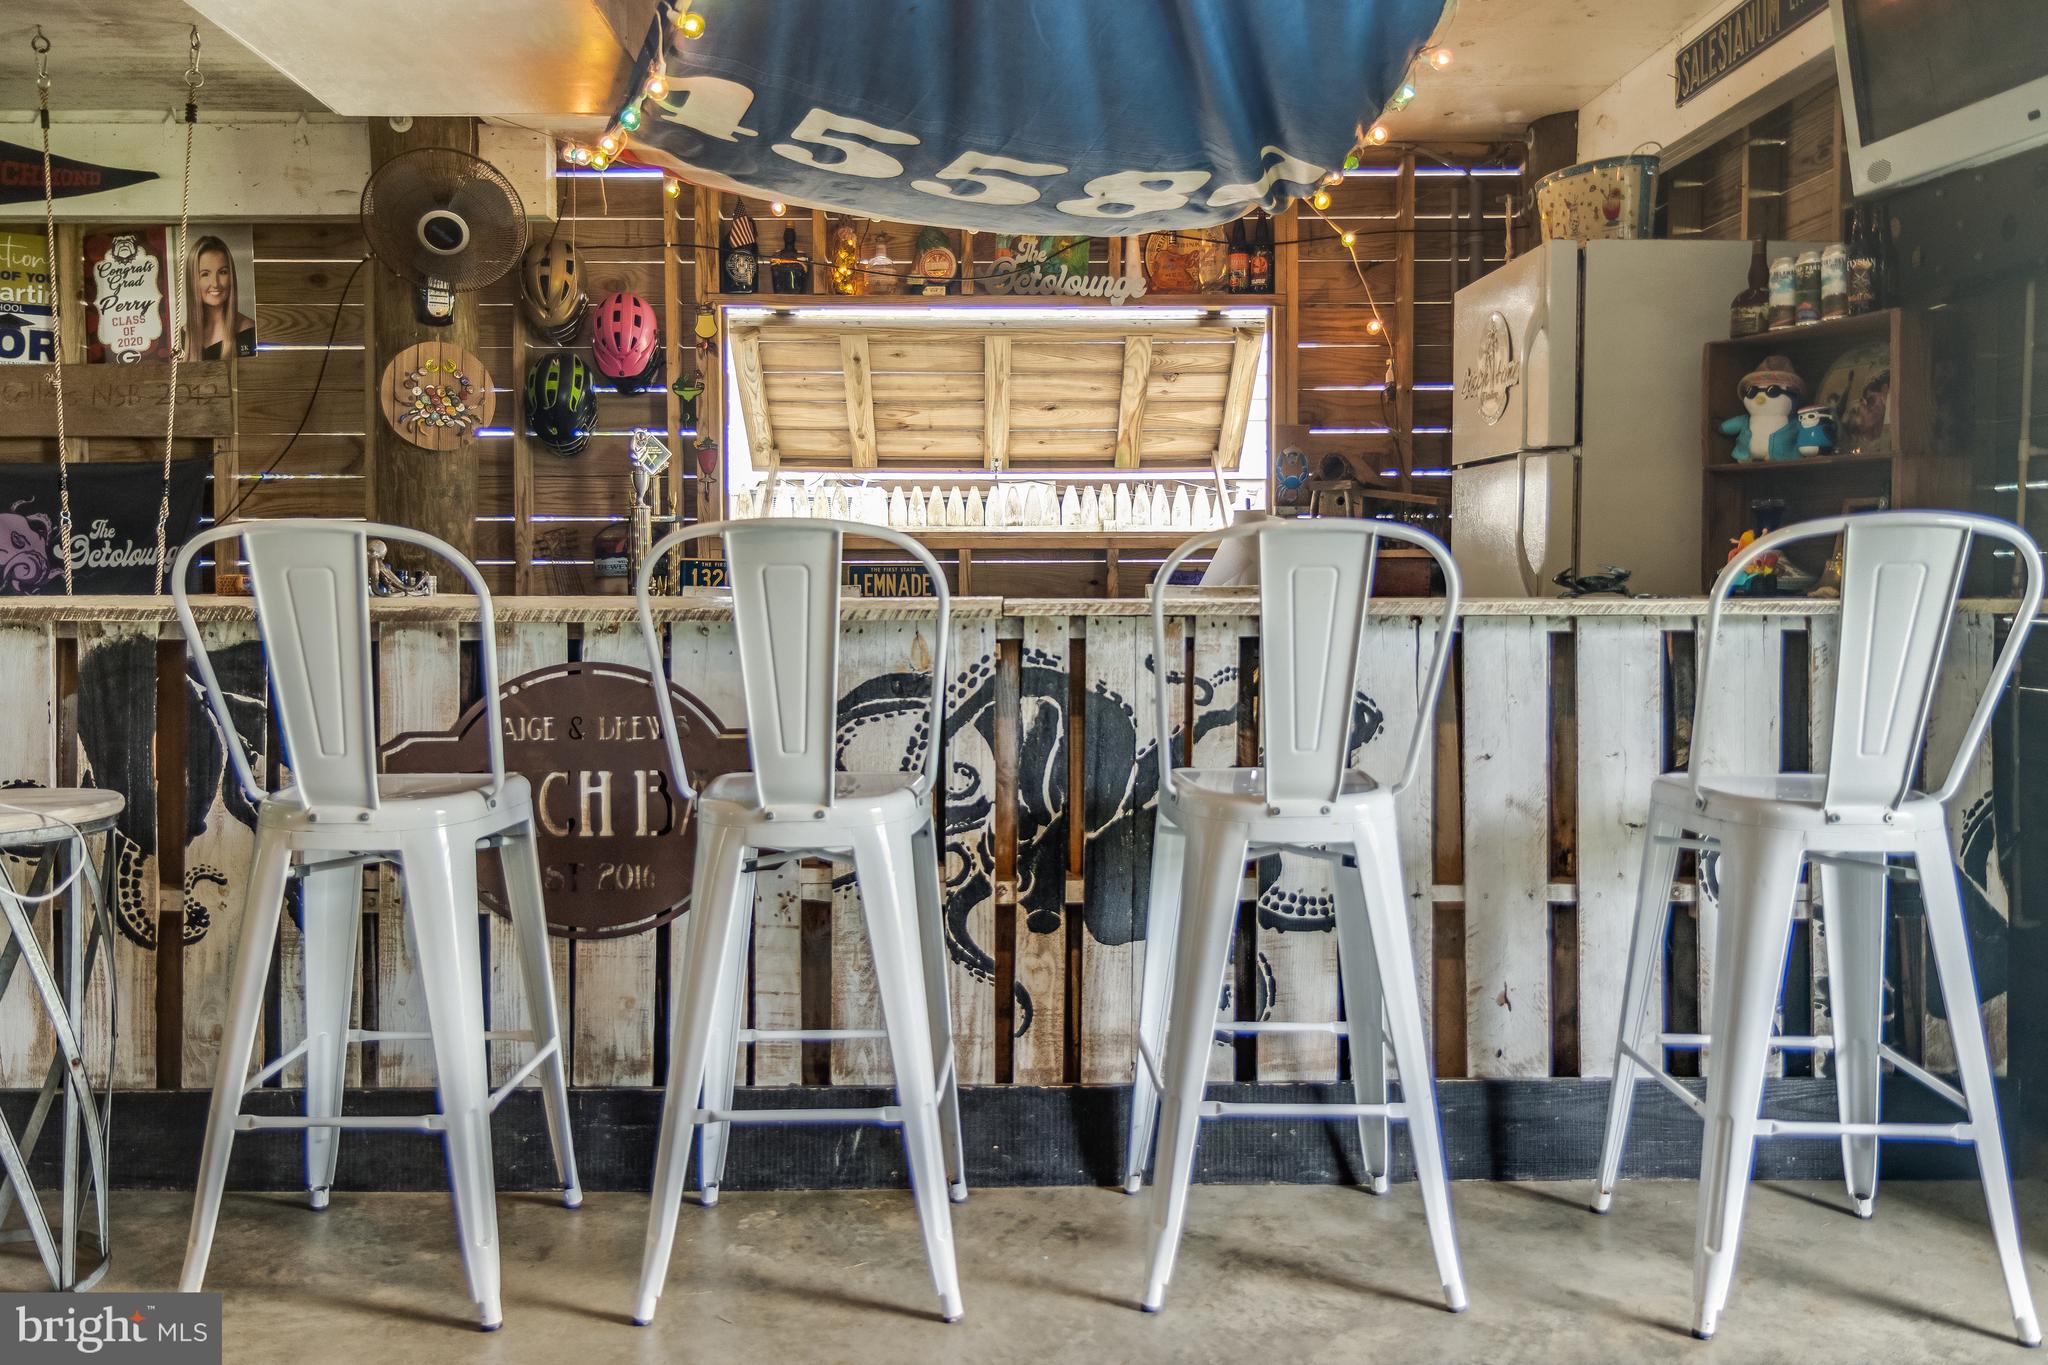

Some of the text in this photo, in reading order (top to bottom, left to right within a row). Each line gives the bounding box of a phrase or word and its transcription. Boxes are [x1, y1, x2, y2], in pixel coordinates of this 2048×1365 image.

[1680, 0, 1780, 98] SALESIANUM
[1015, 237, 1048, 264] The
[0, 270, 21, 281] OF
[97, 260, 155, 279] Congrats
[107, 274, 145, 295] Grad
[983, 256, 1148, 307] Octolounge
[99, 295, 156, 316] Perry
[112, 315, 146, 327] CLASS
[123, 326, 136, 336] OF
[118, 336, 144, 347] 2020
[89, 519, 116, 540] The
[691, 568, 729, 586] 132
[504, 715, 559, 742] AIGE
[568, 715, 585, 741] &
[544, 862, 657, 892] ST 2016
